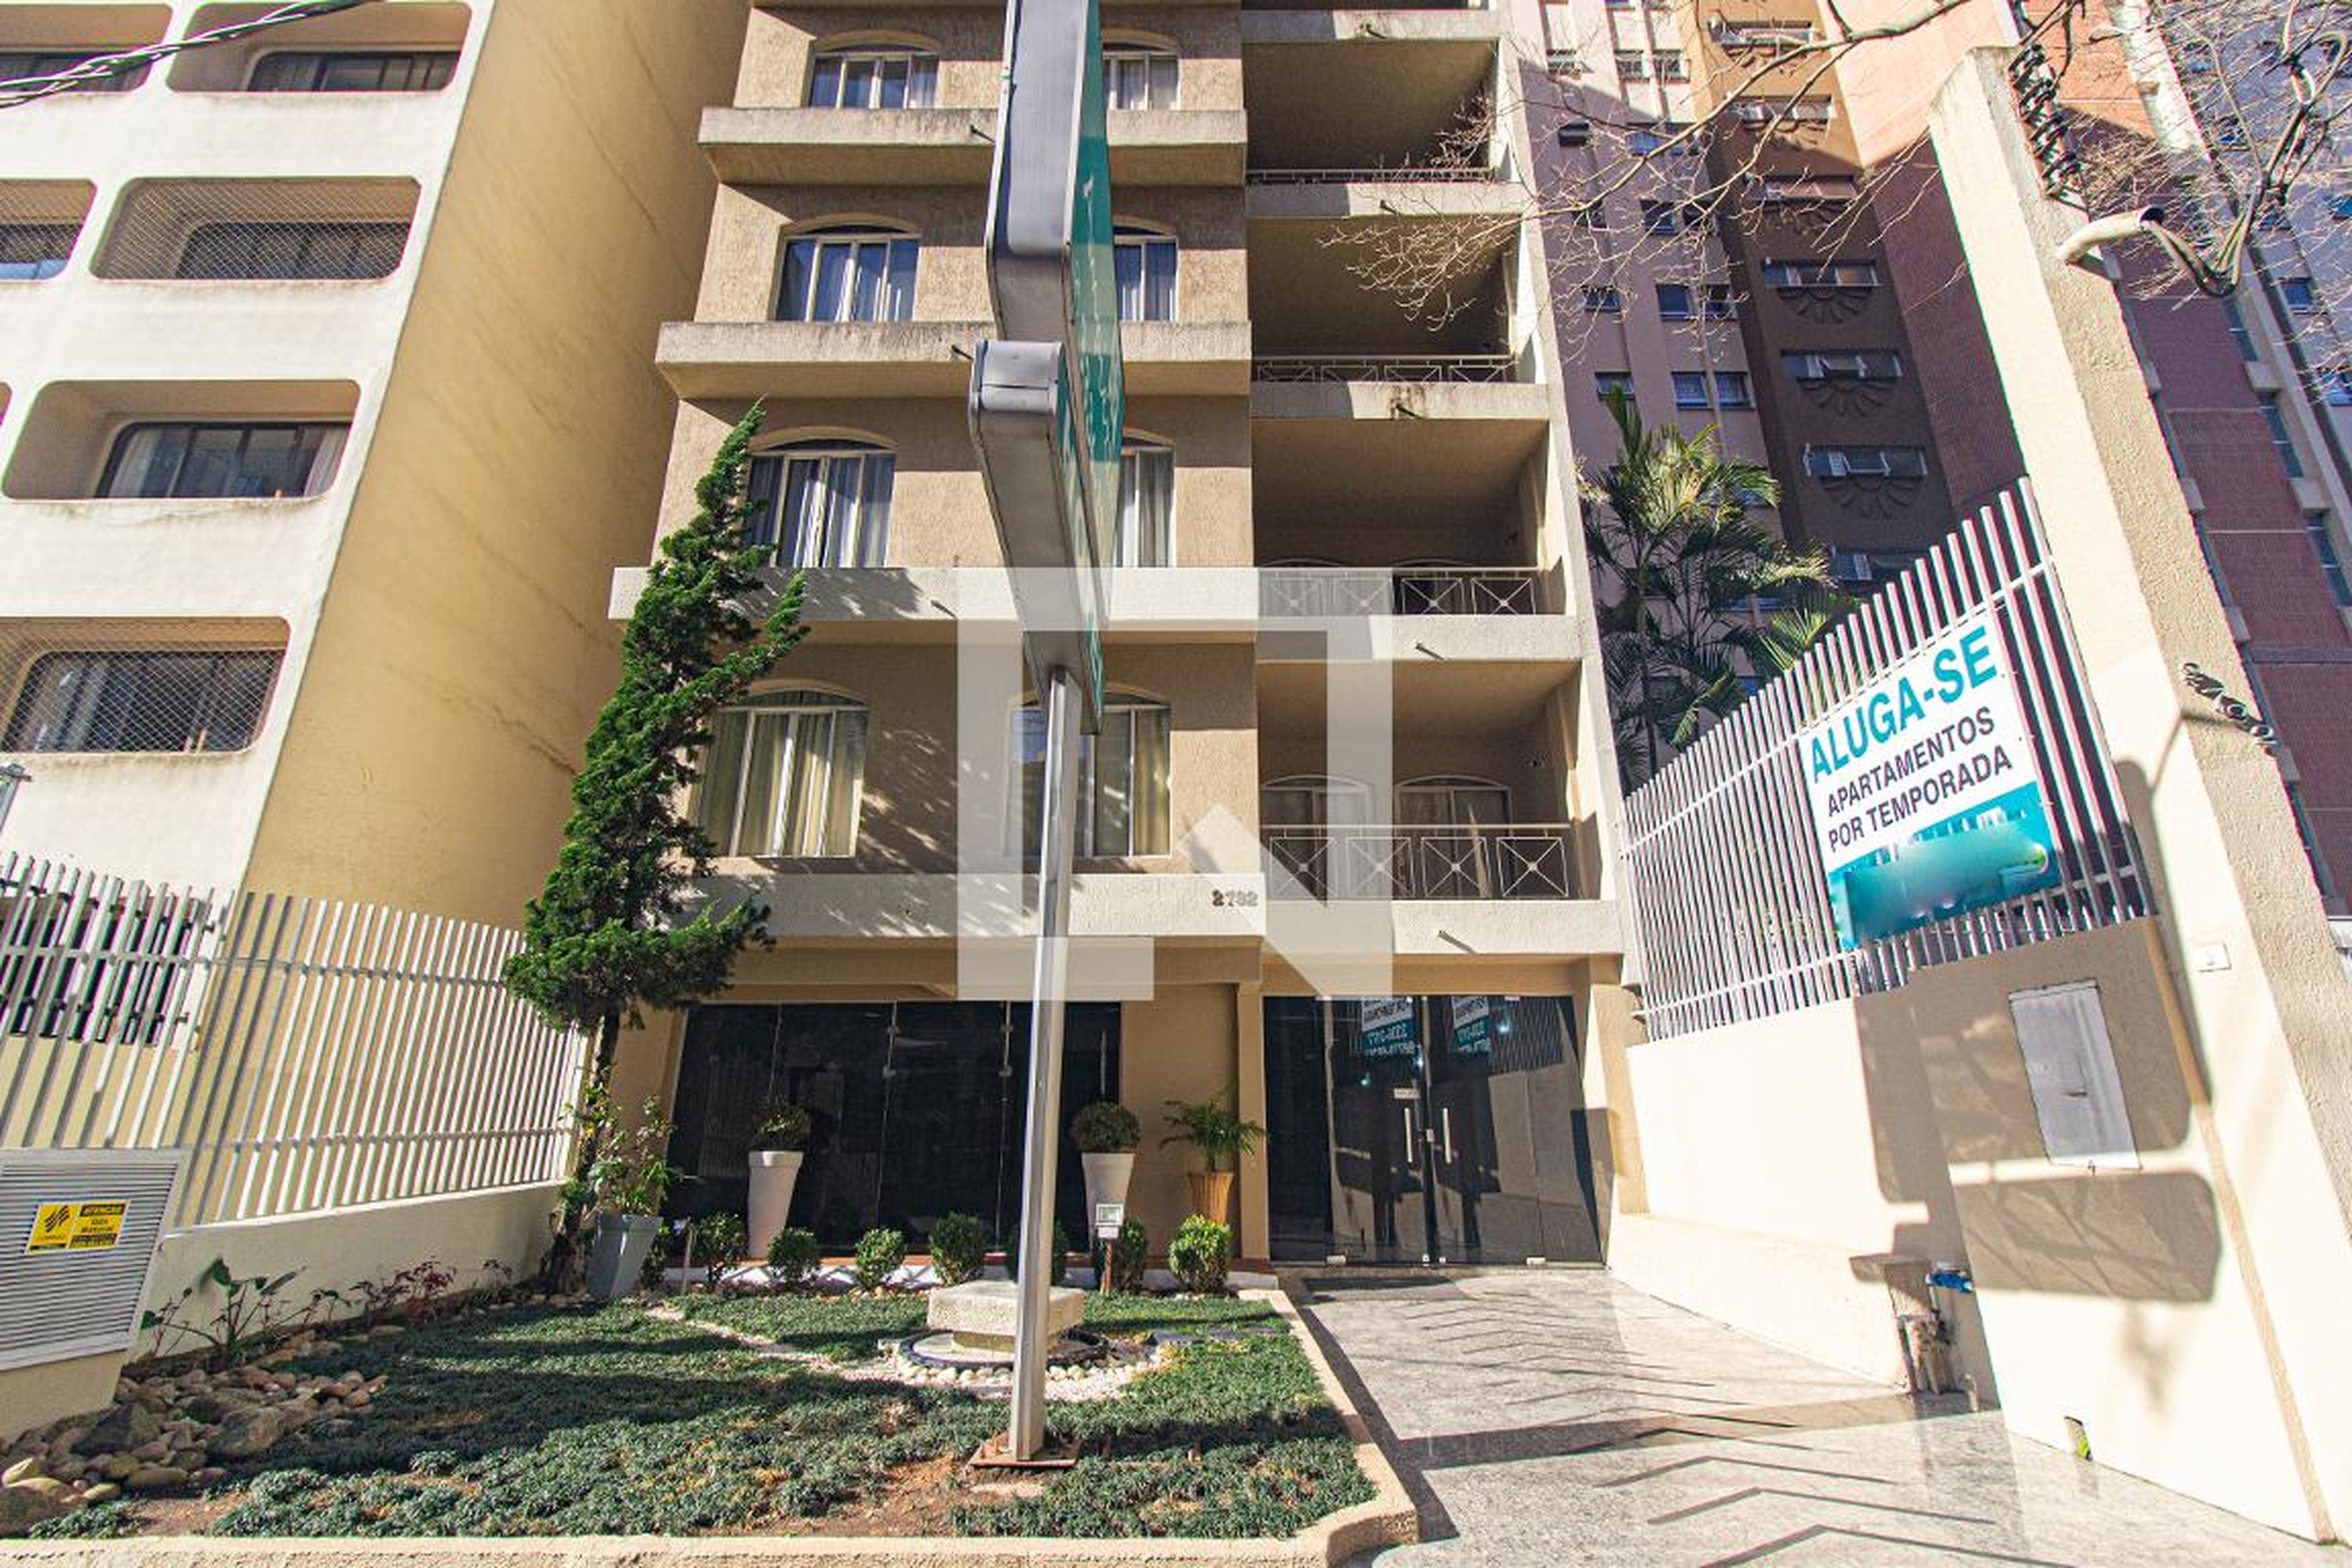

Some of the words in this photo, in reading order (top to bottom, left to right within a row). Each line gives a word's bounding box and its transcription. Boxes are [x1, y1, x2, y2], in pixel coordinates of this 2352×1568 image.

[1813, 625, 1997, 782] ALUGA-SE
[1828, 706, 1995, 816] APARTAMENTOS
[1829, 817, 1864, 852] POR
[1866, 745, 2012, 832] TEMPORADA
